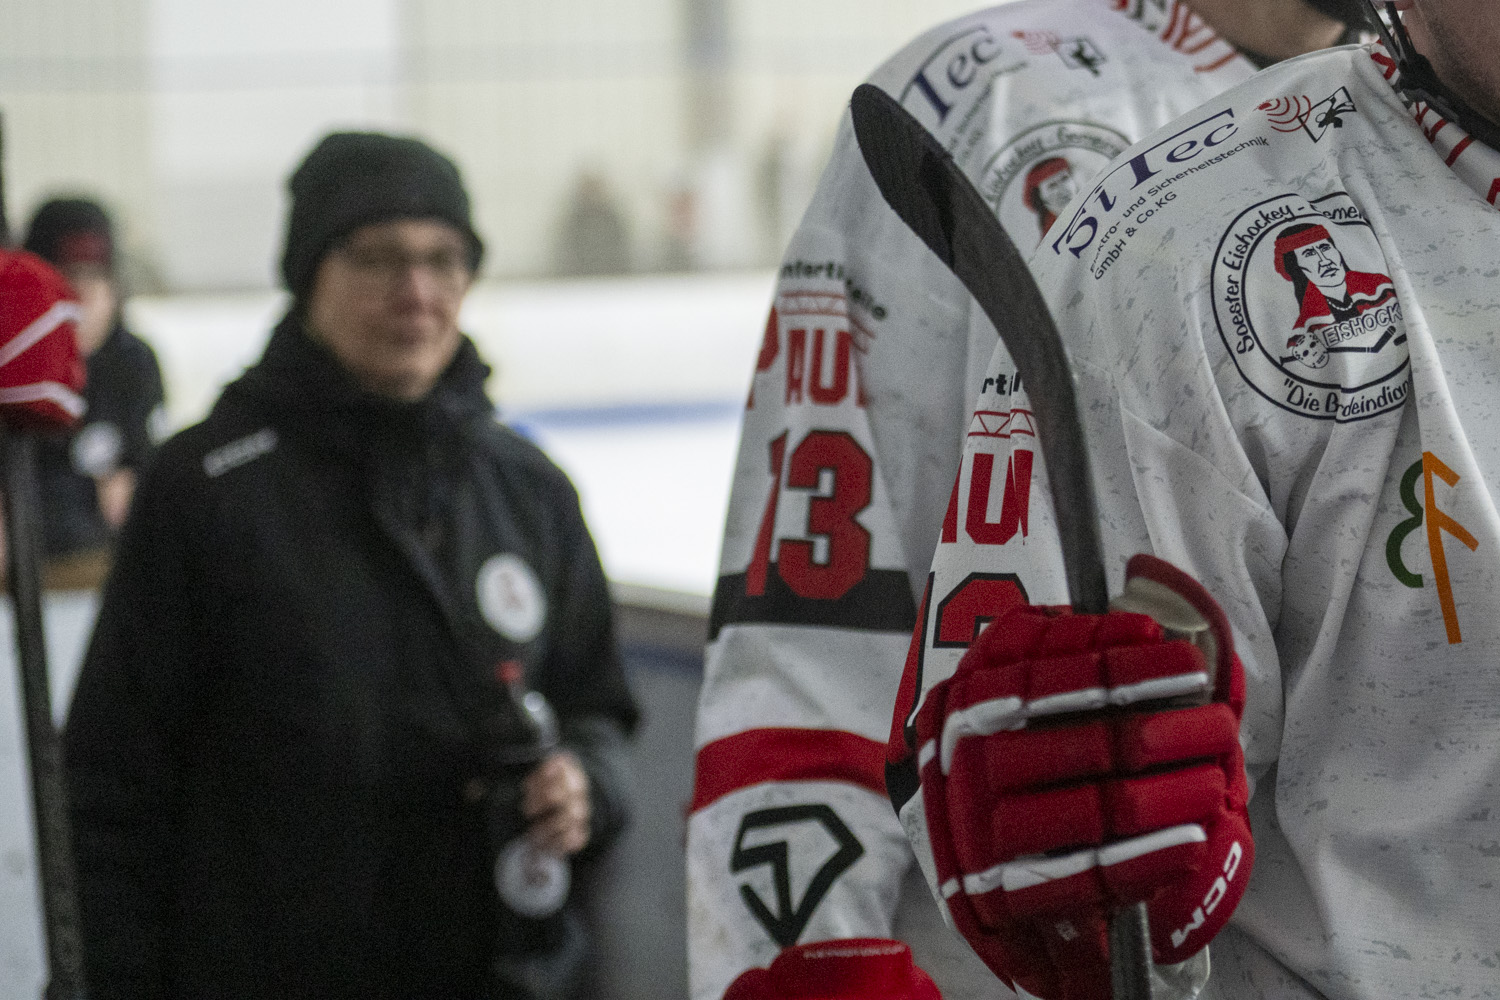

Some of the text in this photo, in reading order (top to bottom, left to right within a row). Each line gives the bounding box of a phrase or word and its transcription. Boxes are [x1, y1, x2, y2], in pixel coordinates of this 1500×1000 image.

[1122, 196, 1147, 219] und
[1147, 136, 1270, 197] Sicherheitstechnik
[1094, 191, 1178, 280] GmbH & Co.KG
[1222, 204, 1296, 271] Eishockey
[1225, 274, 1255, 356] Soester
[1170, 841, 1243, 949] CCM
